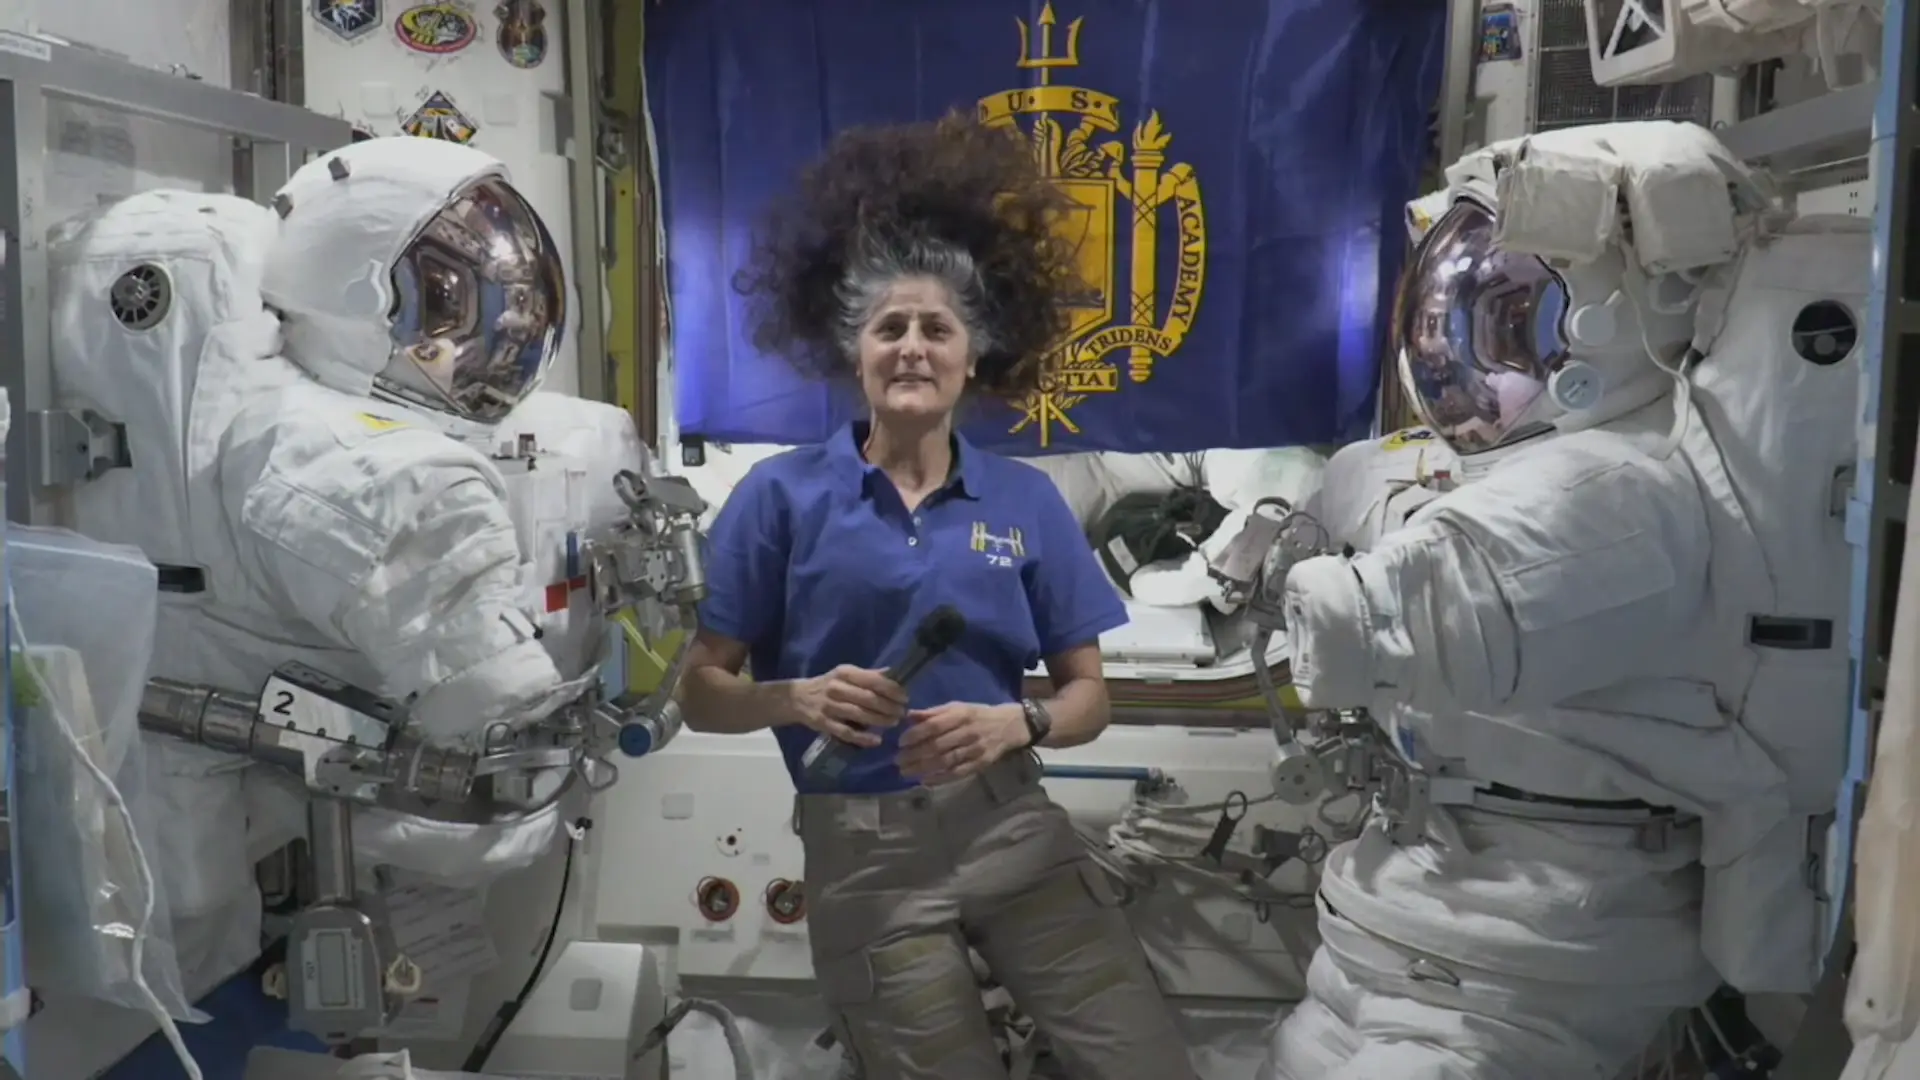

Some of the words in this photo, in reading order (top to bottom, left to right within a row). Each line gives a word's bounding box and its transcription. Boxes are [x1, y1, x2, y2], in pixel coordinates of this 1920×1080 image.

[1173, 195, 1201, 326] ACADEMY
[1085, 328, 1172, 356] TRIDENS
[986, 554, 1012, 567] 72
[273, 691, 294, 715] 2
